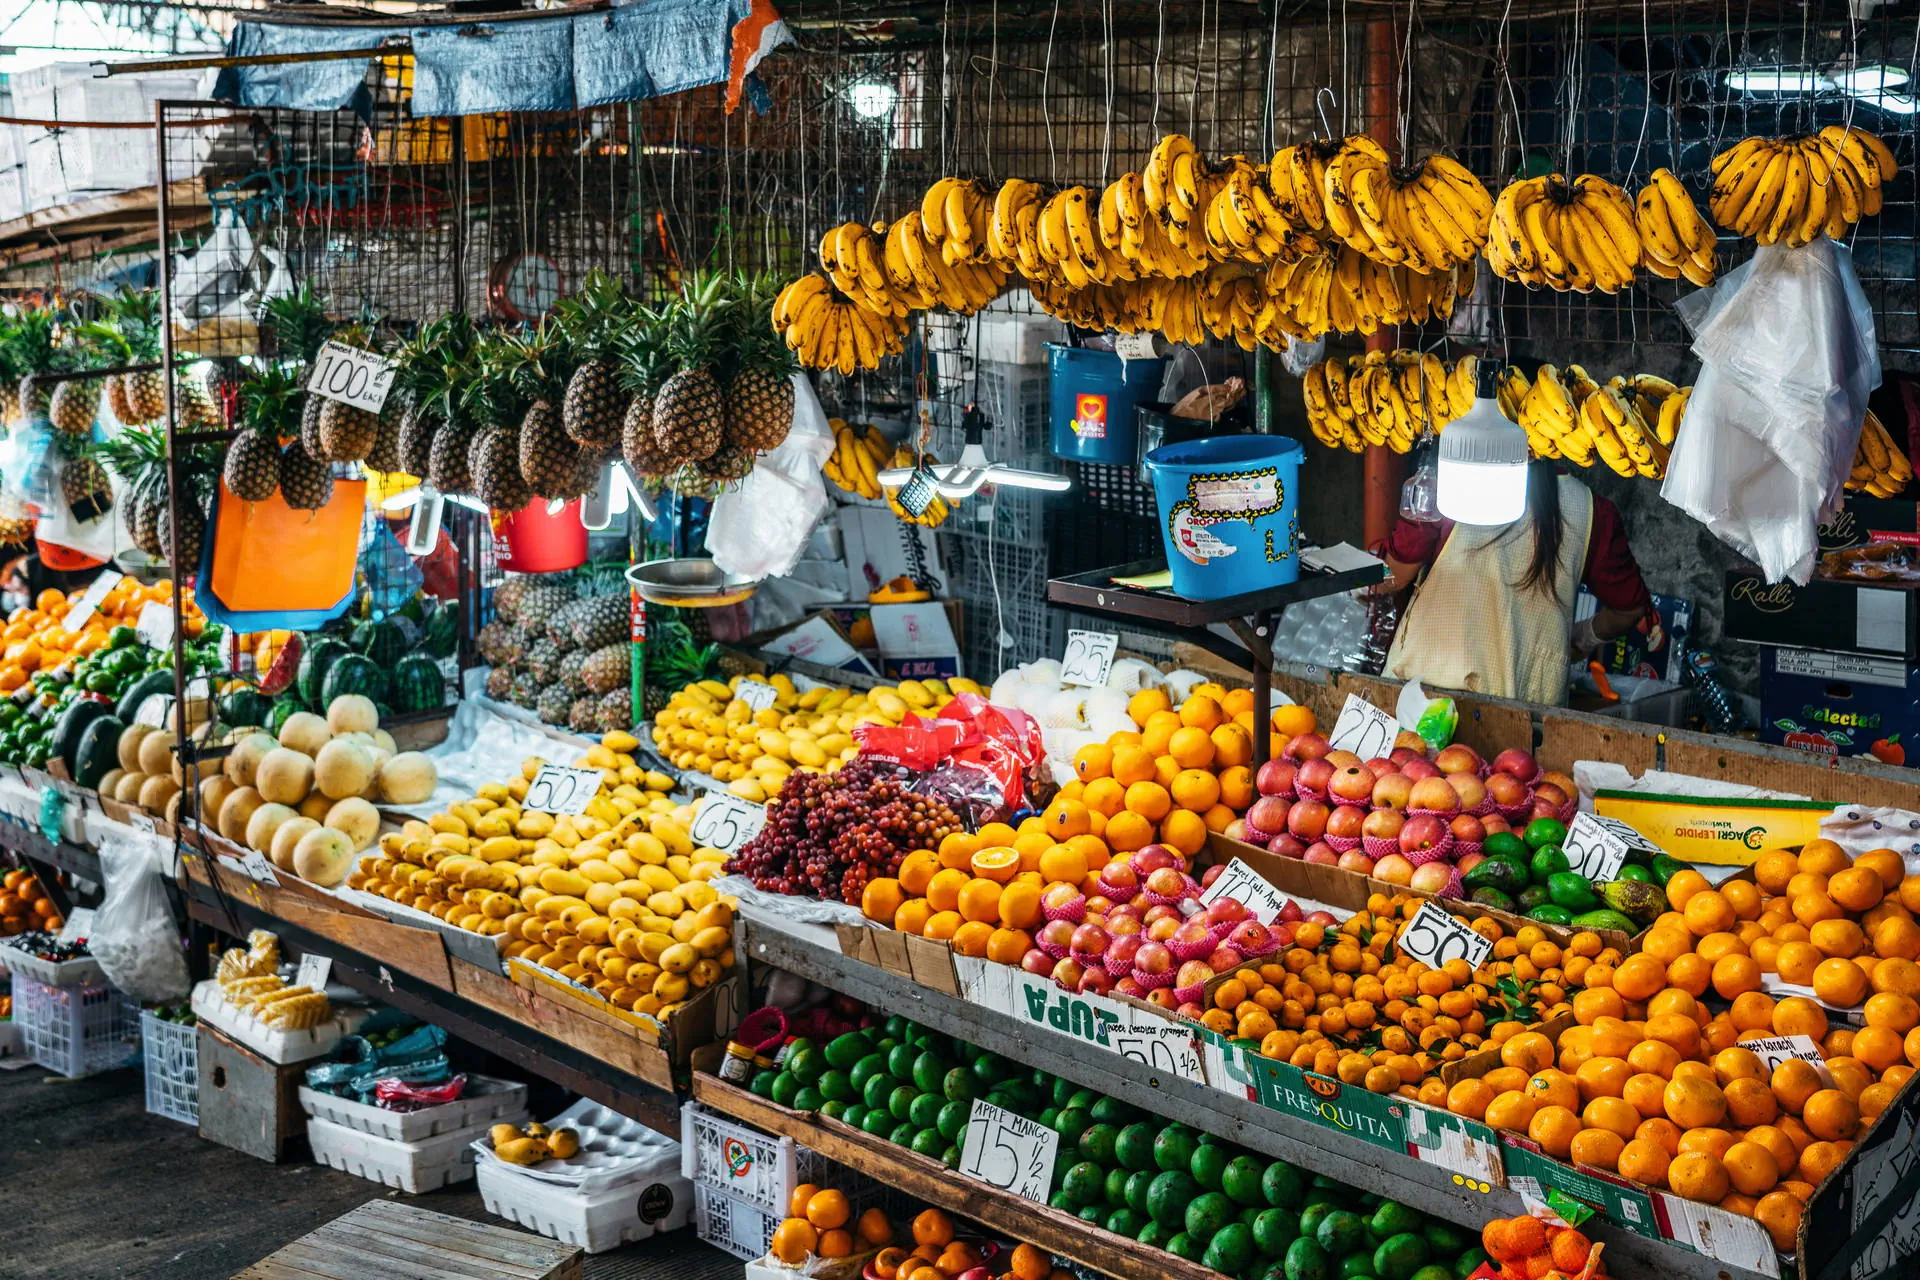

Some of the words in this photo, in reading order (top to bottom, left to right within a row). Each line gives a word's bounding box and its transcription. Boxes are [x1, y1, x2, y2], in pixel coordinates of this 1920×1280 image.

[315, 355, 368, 399] 100
[1186, 517, 1228, 526] OROCA
[1731, 577, 1794, 613] Ralli
[1064, 639, 1108, 681] 25
[1802, 704, 1881, 728] Selected
[528, 772, 577, 810] 50
[694, 802, 747, 849] 65
[1675, 827, 1716, 840] LEPIDIO
[1718, 830, 1744, 841] AGRI
[1566, 828, 1606, 881] 50
[1406, 911, 1469, 969] 50
[1023, 983, 1119, 1047] ZUPA
[974, 1102, 1007, 1123] APPLE
[1011, 1116, 1050, 1143] MANGO
[1271, 1083, 1393, 1142] FRESQUITA
[967, 1118, 1025, 1190] 15
[1028, 1141, 1044, 1180] 1/2
